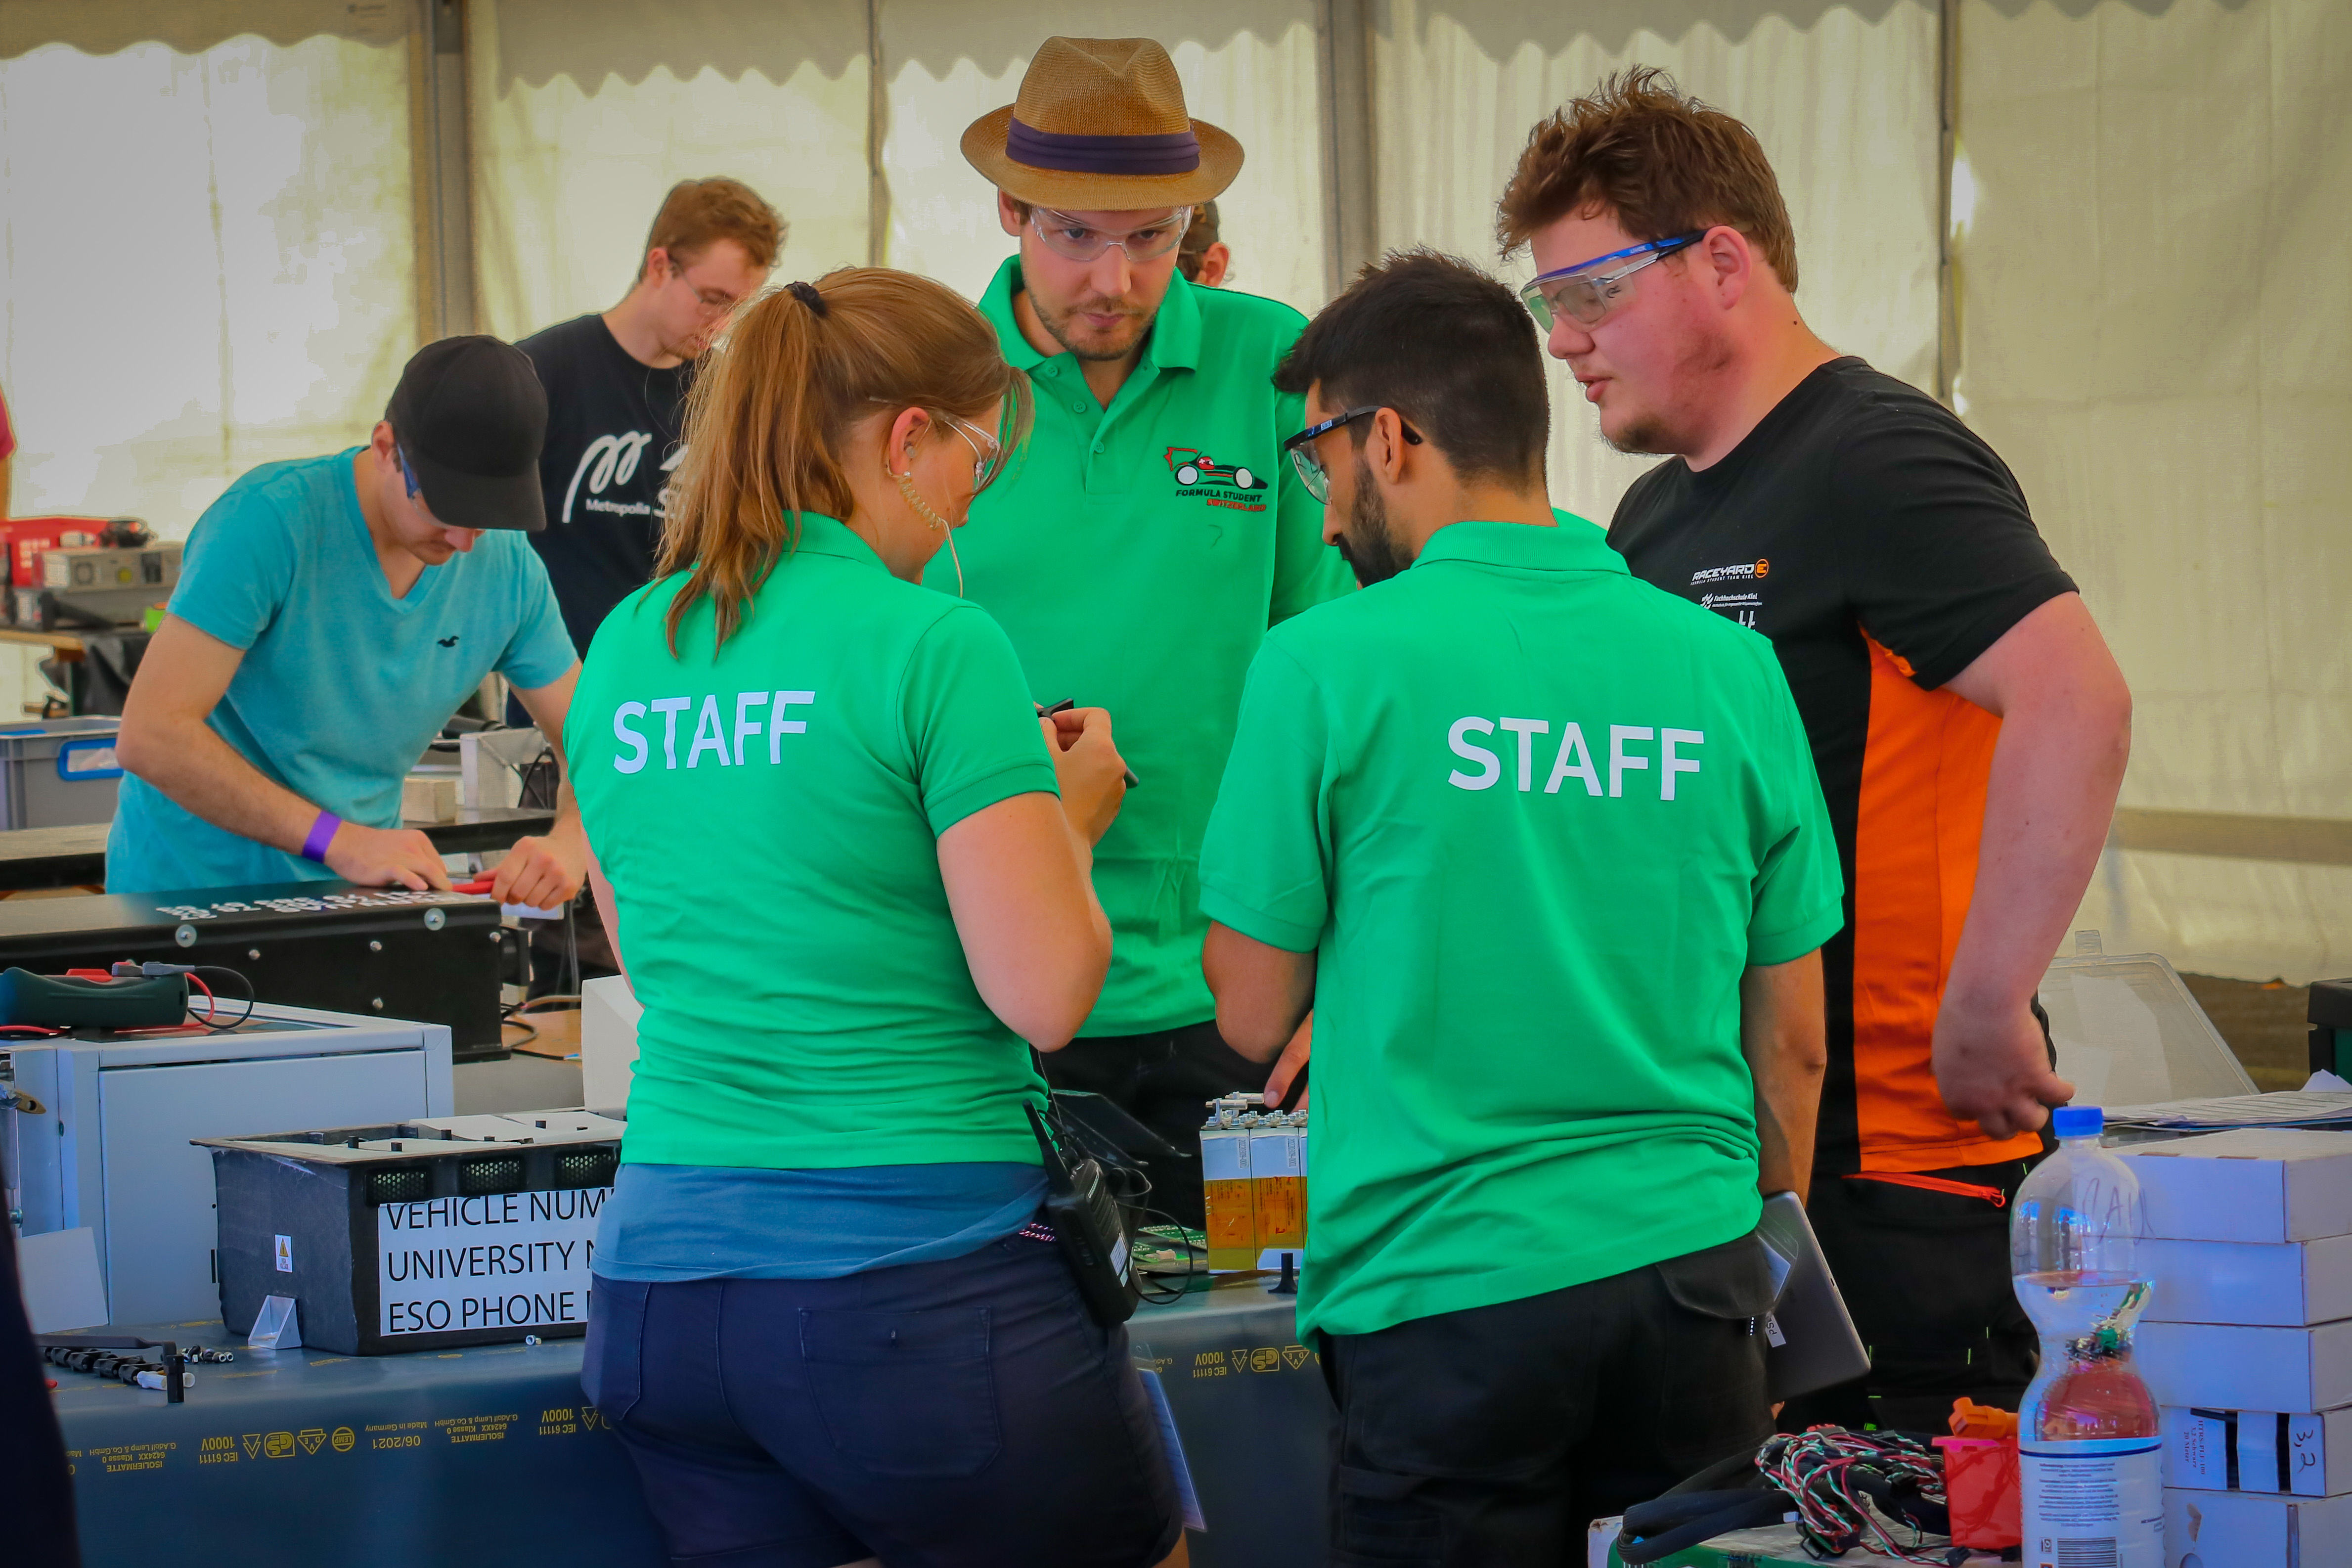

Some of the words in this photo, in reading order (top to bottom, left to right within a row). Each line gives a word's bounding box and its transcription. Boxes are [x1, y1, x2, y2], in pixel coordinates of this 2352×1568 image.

[1223, 491, 1262, 502] STUDENT
[586, 498, 651, 517] Metropolia
[1206, 499, 1266, 512] SWITZERLAND
[1692, 564, 1755, 581] RACEYARD
[1714, 593, 1747, 602] Fachhochschule
[613, 690, 816, 774] STAFF
[1448, 716, 1704, 801] STAFF
[387, 1193, 518, 1230] VEHICLE
[530, 1187, 615, 1222] NUM
[388, 1241, 575, 1281] UNIVERSITY
[389, 1299, 451, 1333] ESO
[462, 1292, 575, 1328] PHONE
[1195, 1352, 1225, 1366] 1000V
[1193, 1368, 1212, 1378] 61111
[1214, 1367, 1227, 1376] IEC
[541, 1408, 574, 1423] 1000V
[435, 1418, 466, 1427] Co.GmbH
[482, 1423, 507, 1432] 6424XX
[539, 1425, 560, 1435] 61111
[562, 1424, 576, 1433] IEC
[334, 1434, 352, 1443] LEMP
[372, 1435, 421, 1449] 06/2021
[451, 1432, 504, 1443] ISOLIERMATTE
[201, 1436, 235, 1451] 1000V
[89, 1447, 123, 1456] Co.GmbH
[138, 1451, 165, 1460] 6424XX
[2294, 1429, 2316, 1473] 3,2
[199, 1453, 222, 1464] 61111
[223, 1452, 238, 1462] IEC
[107, 1461, 162, 1472] ISOLIERMATTE
